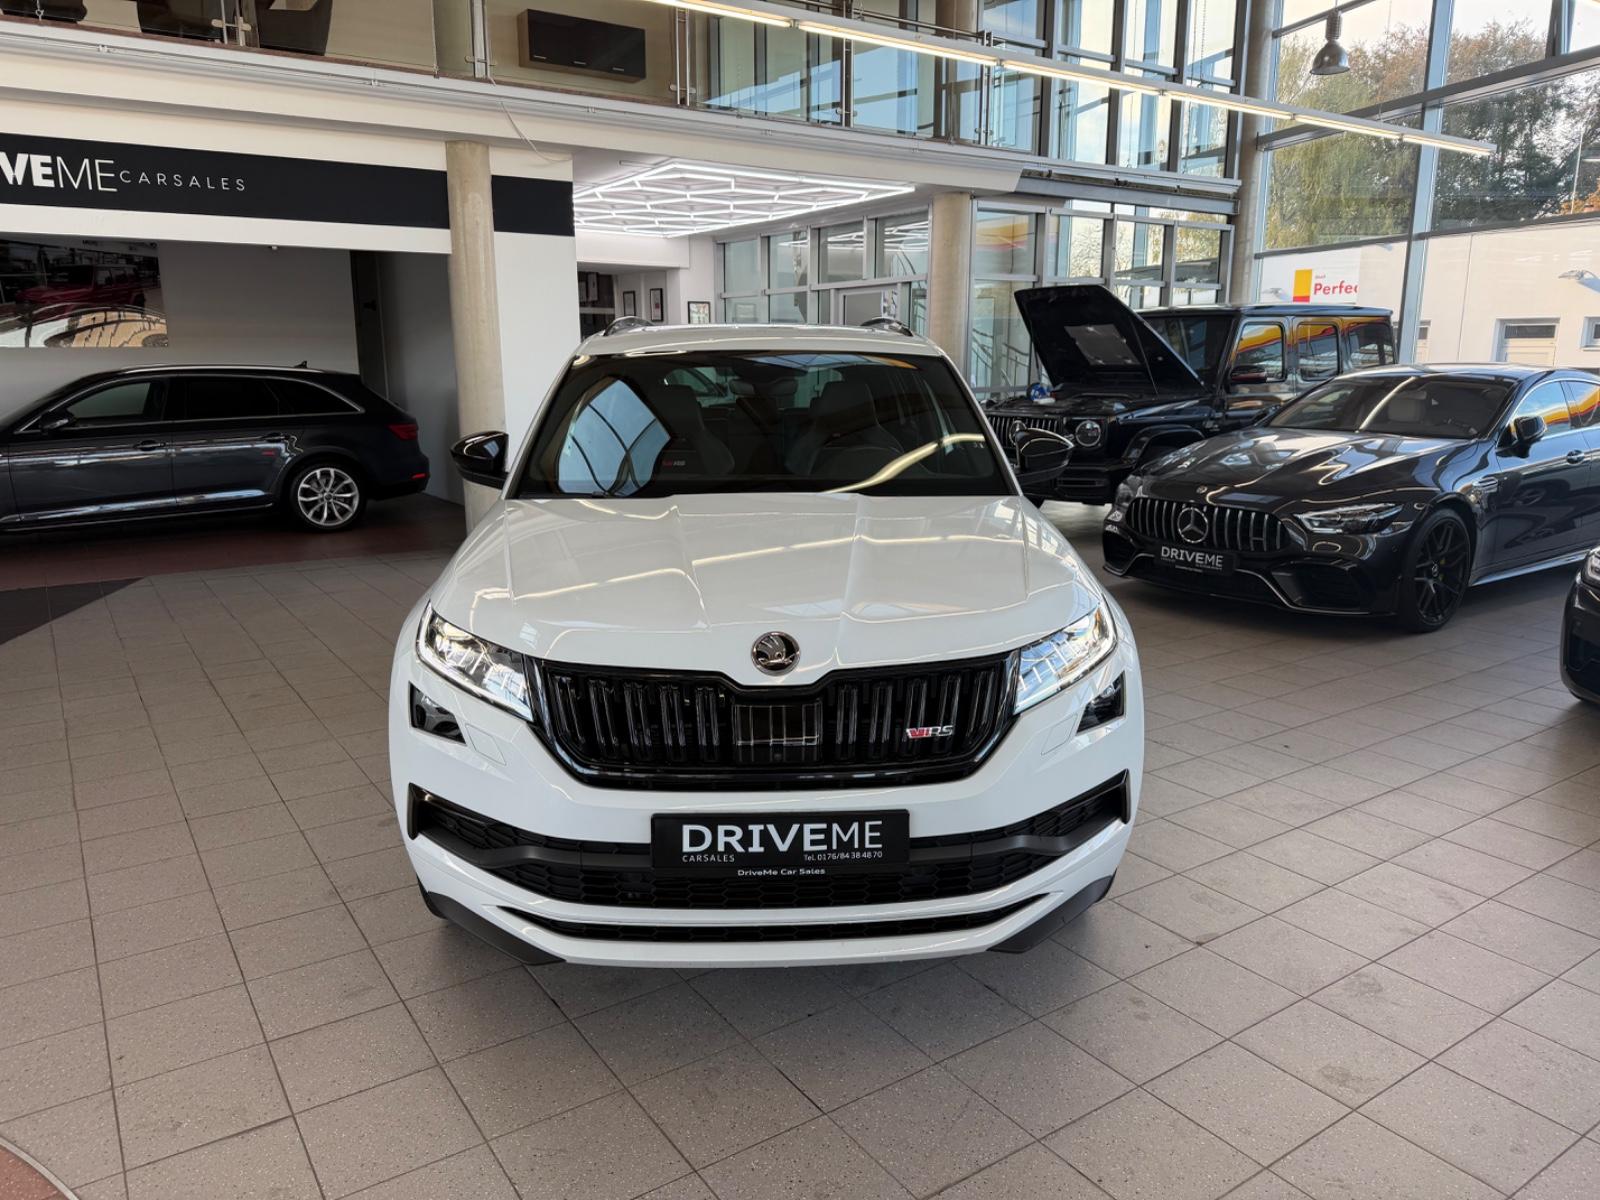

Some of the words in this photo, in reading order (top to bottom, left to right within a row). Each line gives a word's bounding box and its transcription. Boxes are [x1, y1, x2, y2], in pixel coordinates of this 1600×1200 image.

[119, 170, 246, 192] CARSALES
[1161, 546, 1224, 567] DRIVEME
[682, 820, 883, 853] DRIVEME
[682, 854, 736, 863] CARSALES
[737, 868, 779, 876] DriveMe
[780, 868, 797, 876] Car
[799, 867, 826, 876] Sales
